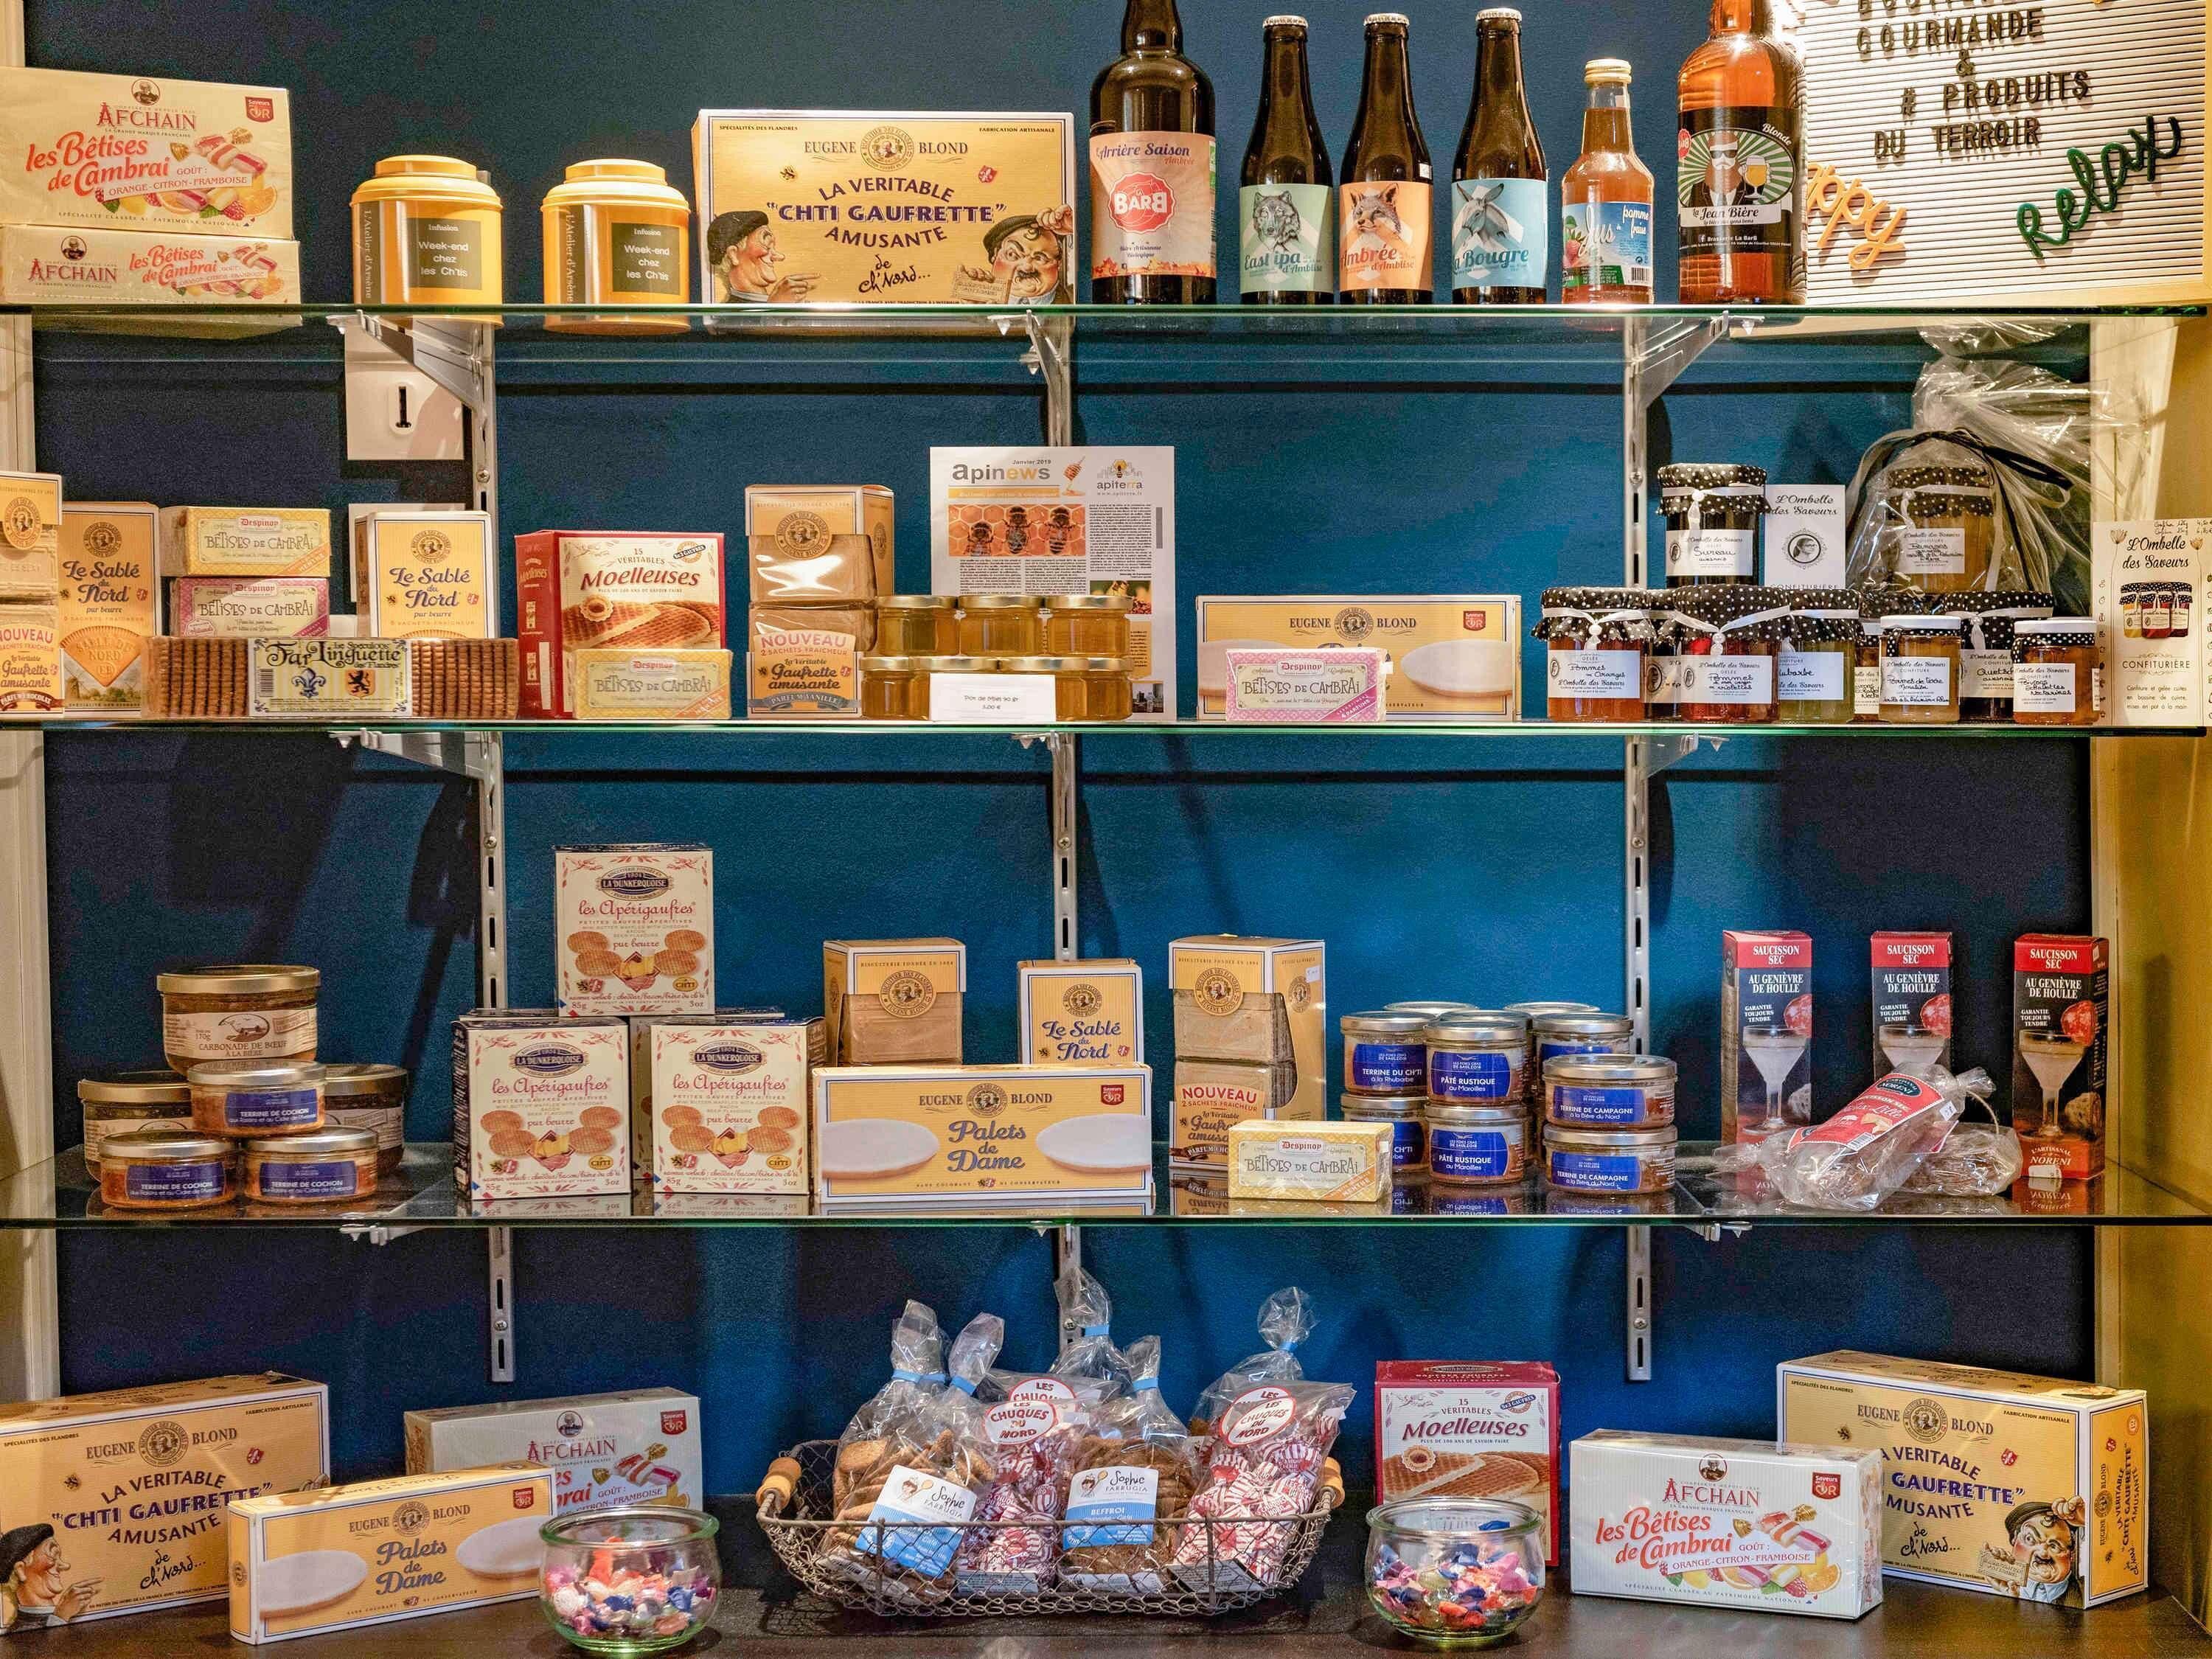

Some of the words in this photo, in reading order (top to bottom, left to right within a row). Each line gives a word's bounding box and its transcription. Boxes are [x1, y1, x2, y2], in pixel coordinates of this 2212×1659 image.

[1857, 7, 2045, 54] GOURMANDE
[1956, 49, 1975, 77] &
[1901, 88, 1916, 116] #
[97, 102, 197, 131] AFCHAIN
[1762, 122, 1792, 146] Blonde
[25, 143, 57, 172] les
[56, 131, 147, 166] Bêtises
[804, 141, 857, 154] EUGENE
[919, 142, 968, 154] BLOND
[1144, 142, 1190, 157] Saison
[1874, 129, 1905, 159] DU
[47, 169, 72, 192] de
[74, 156, 170, 197] Cambrai
[818, 182, 846, 201] LA
[848, 177, 954, 203] VERITABLE
[1700, 206, 1725, 220] Jean
[1728, 206, 1759, 218] Bière
[428, 223, 459, 232] Infusion
[824, 226, 947, 248] AMUSANTE
[418, 241, 468, 252] Week-end
[625, 244, 669, 256] Week-end
[129, 254, 147, 271] les
[147, 245, 204, 263] Bêtises
[434, 254, 456, 264] chez
[639, 258, 660, 268] chez
[875, 254, 891, 270] de
[1463, 248, 1529, 270] Bougre
[28, 258, 118, 282] AFCHAIN
[421, 266, 436, 276] les
[952, 463, 1051, 484] apinews
[1096, 481, 1142, 492] apiterra
[1772, 507, 1790, 515] des
[1793, 507, 1837, 516] Saveurs
[254, 540, 265, 548] DE
[62, 560, 87, 581] Le
[90, 561, 140, 579] Sablé
[389, 566, 415, 585] Le
[417, 567, 471, 585] Sablé
[580, 567, 700, 591] Moelleuses
[77, 583, 129, 603] Nord
[405, 589, 459, 608] Nord
[1290, 618, 1331, 628] EUGENE
[1377, 618, 1416, 628] BLOND
[761, 633, 846, 648] NOUVEAU
[771, 663, 838, 680] Gaufrette
[2122, 659, 2191, 669] CONFITURIÈRE
[768, 678, 841, 689] amusante
[579, 900, 595, 915] les
[599, 899, 693, 920] Apérigaufres
[1753, 945, 1800, 956] SAUCISSON
[1888, 945, 1935, 955] SAUCISSON
[2030, 948, 2078, 960] SAUCISSON
[1768, 955, 1784, 964] SEC
[1903, 955, 1919, 964] SEC
[2045, 959, 2062, 969] SEC
[1748, 974, 1761, 984] AU
[1762, 971, 1804, 984] GENIÈVRE
[1884, 974, 1896, 984] AU
[1896, 970, 1939, 984] GENIÈVRE
[2025, 978, 2037, 987] AU
[2039, 976, 2081, 990] GENIÈVRE
[1753, 984, 1766, 993] DE
[1767, 984, 1800, 993] HOULLE
[1888, 984, 1900, 993] DE
[1902, 984, 1936, 993] HOULLE
[2029, 988, 2042, 998] DE
[2043, 988, 2078, 999] HOULLE
[1042, 1020, 1066, 1040] Le
[1069, 1020, 1121, 1037] Sablé
[1057, 1041, 1109, 1060] Nord
[493, 1079, 509, 1094] les
[513, 1076, 606, 1098] Apérigaufres
[673, 1074, 689, 1090] les
[693, 1074, 786, 1096] Apérigaufres
[1441, 1077, 1457, 1085] PÂTÉ
[1458, 1077, 1495, 1085] RUSTIQUE
[919, 1094, 963, 1106] EUGENE
[1011, 1093, 1052, 1104] BLOND
[1182, 1087, 1256, 1104] NOUVEAU
[1561, 1105, 1582, 1113] TERRINE
[948, 1120, 1026, 1142] Palets
[978, 1141, 998, 1155] de
[947, 1150, 1025, 1172] Dame
[2030, 1155, 2072, 1166] NORENI
[1036, 1382, 1054, 1391] LES
[990, 1409, 1049, 1422] CHUQUES
[1241, 1409, 1289, 1425] CHUQUES
[1857, 1404, 1900, 1422] EUGENE
[1951, 1419, 1994, 1436] BLOND
[1000, 1429, 1037, 1439] NORD
[1235, 1427, 1270, 1438] NORD
[1402, 1417, 1528, 1440] Moelleuses
[86, 1441, 135, 1459] EUGENE
[192, 1427, 237, 1445] BLOND
[527, 1439, 618, 1464] AFCHAIN
[1895, 1446, 1981, 1481] VERITABLE
[1110, 1470, 1145, 1486] Sophie
[101, 1486, 127, 1505] LA
[129, 1471, 226, 1492] VERITABLE
[1662, 1478, 1759, 1507] AFCHAIN
[931, 1486, 965, 1509] Sophie
[349, 1517, 390, 1532] EUGENE
[433, 1503, 471, 1520] BLOND
[1596, 1517, 1624, 1545] les
[1624, 1506, 1711, 1540] Bêtises
[108, 1513, 220, 1544] AMUSANTE
[377, 1537, 448, 1565] Palets
[1615, 1542, 1637, 1564] de
[1640, 1532, 1733, 1570] Cambrai
[376, 1571, 446, 1596] Dame
